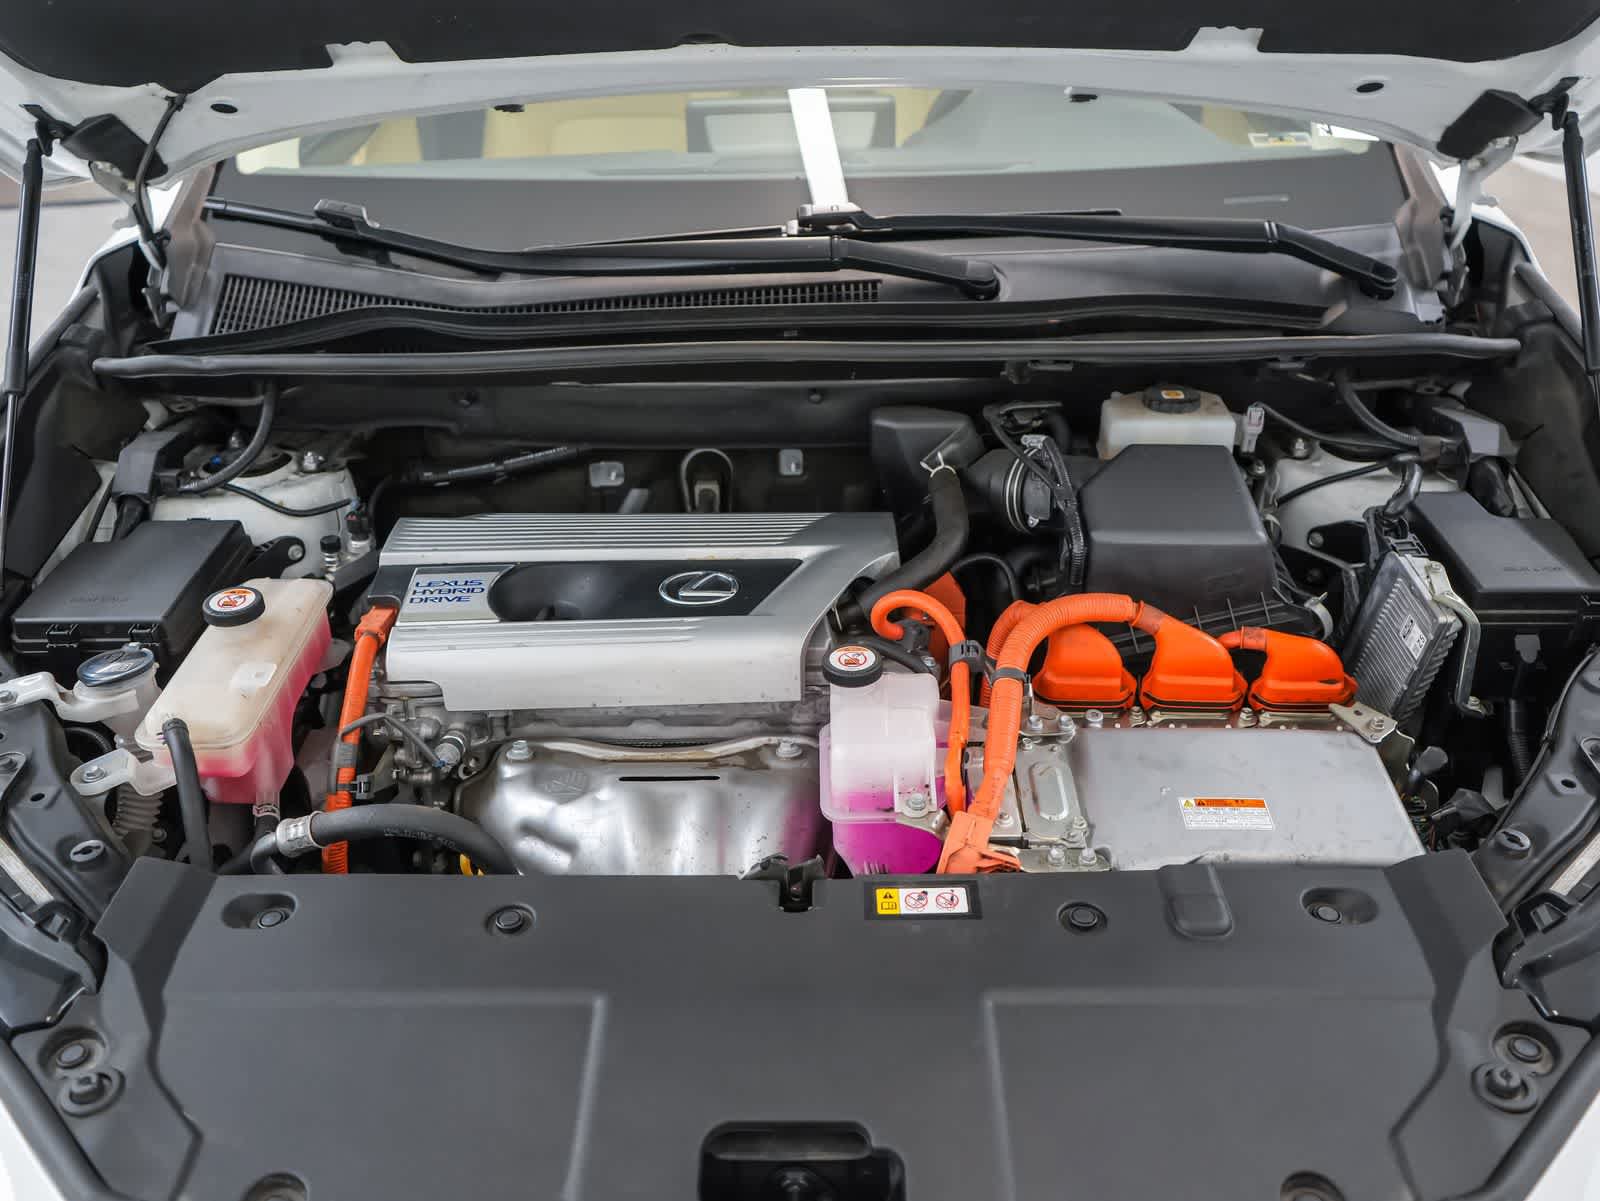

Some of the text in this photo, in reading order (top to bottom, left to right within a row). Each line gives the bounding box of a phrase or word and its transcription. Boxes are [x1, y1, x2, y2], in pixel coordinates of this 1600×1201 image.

[415, 579, 483, 588] LEXUS
[412, 587, 485, 596] HYBRID
[409, 595, 473, 604] DRIVE
